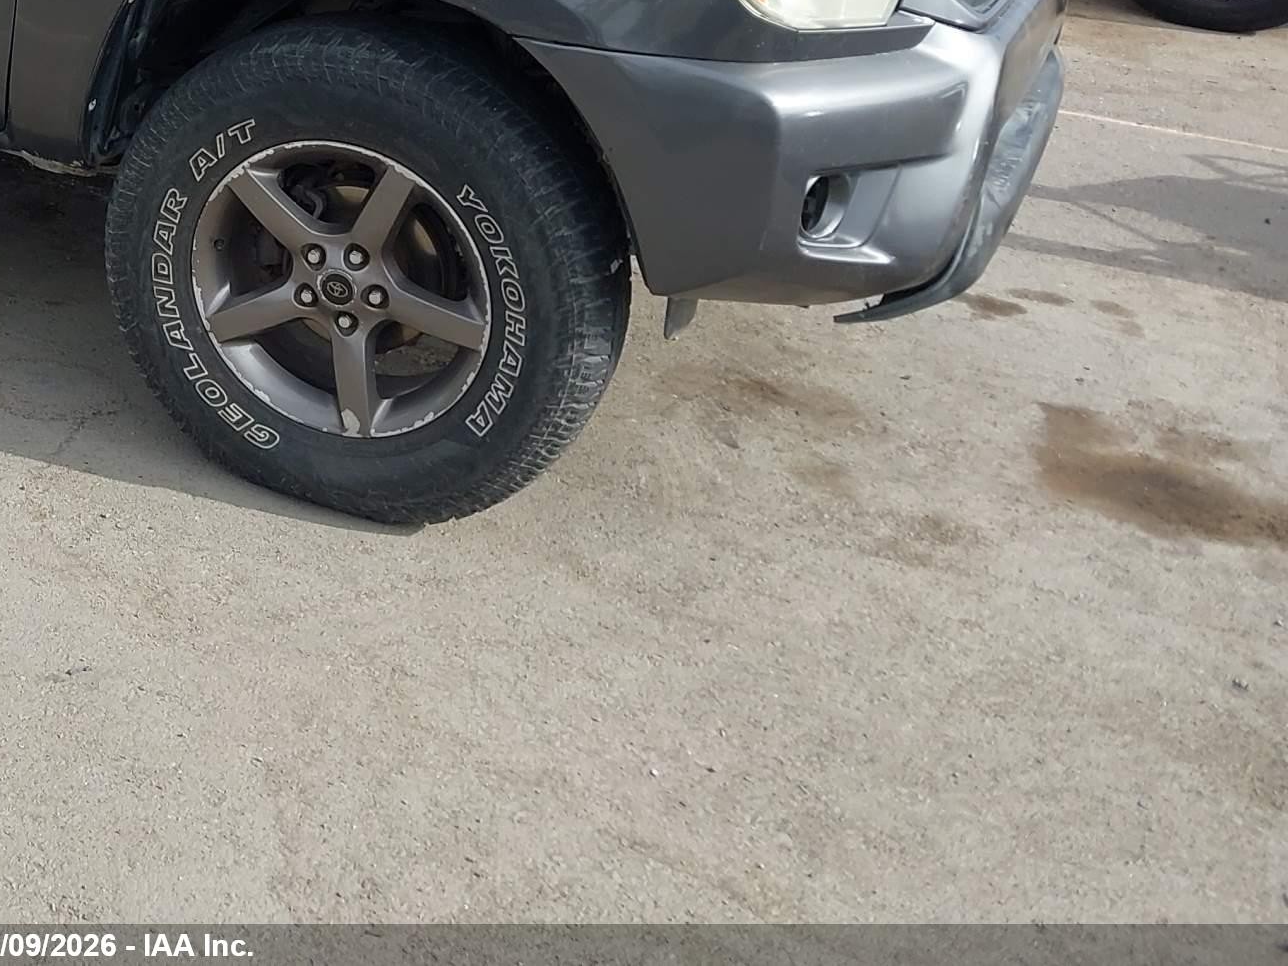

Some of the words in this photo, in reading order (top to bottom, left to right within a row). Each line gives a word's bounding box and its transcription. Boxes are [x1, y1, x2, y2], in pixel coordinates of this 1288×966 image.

[188, 119, 257, 181] A/T
[152, 187, 280, 449] GEOLANDAR
[457, 185, 529, 437] YOKOHAMA
